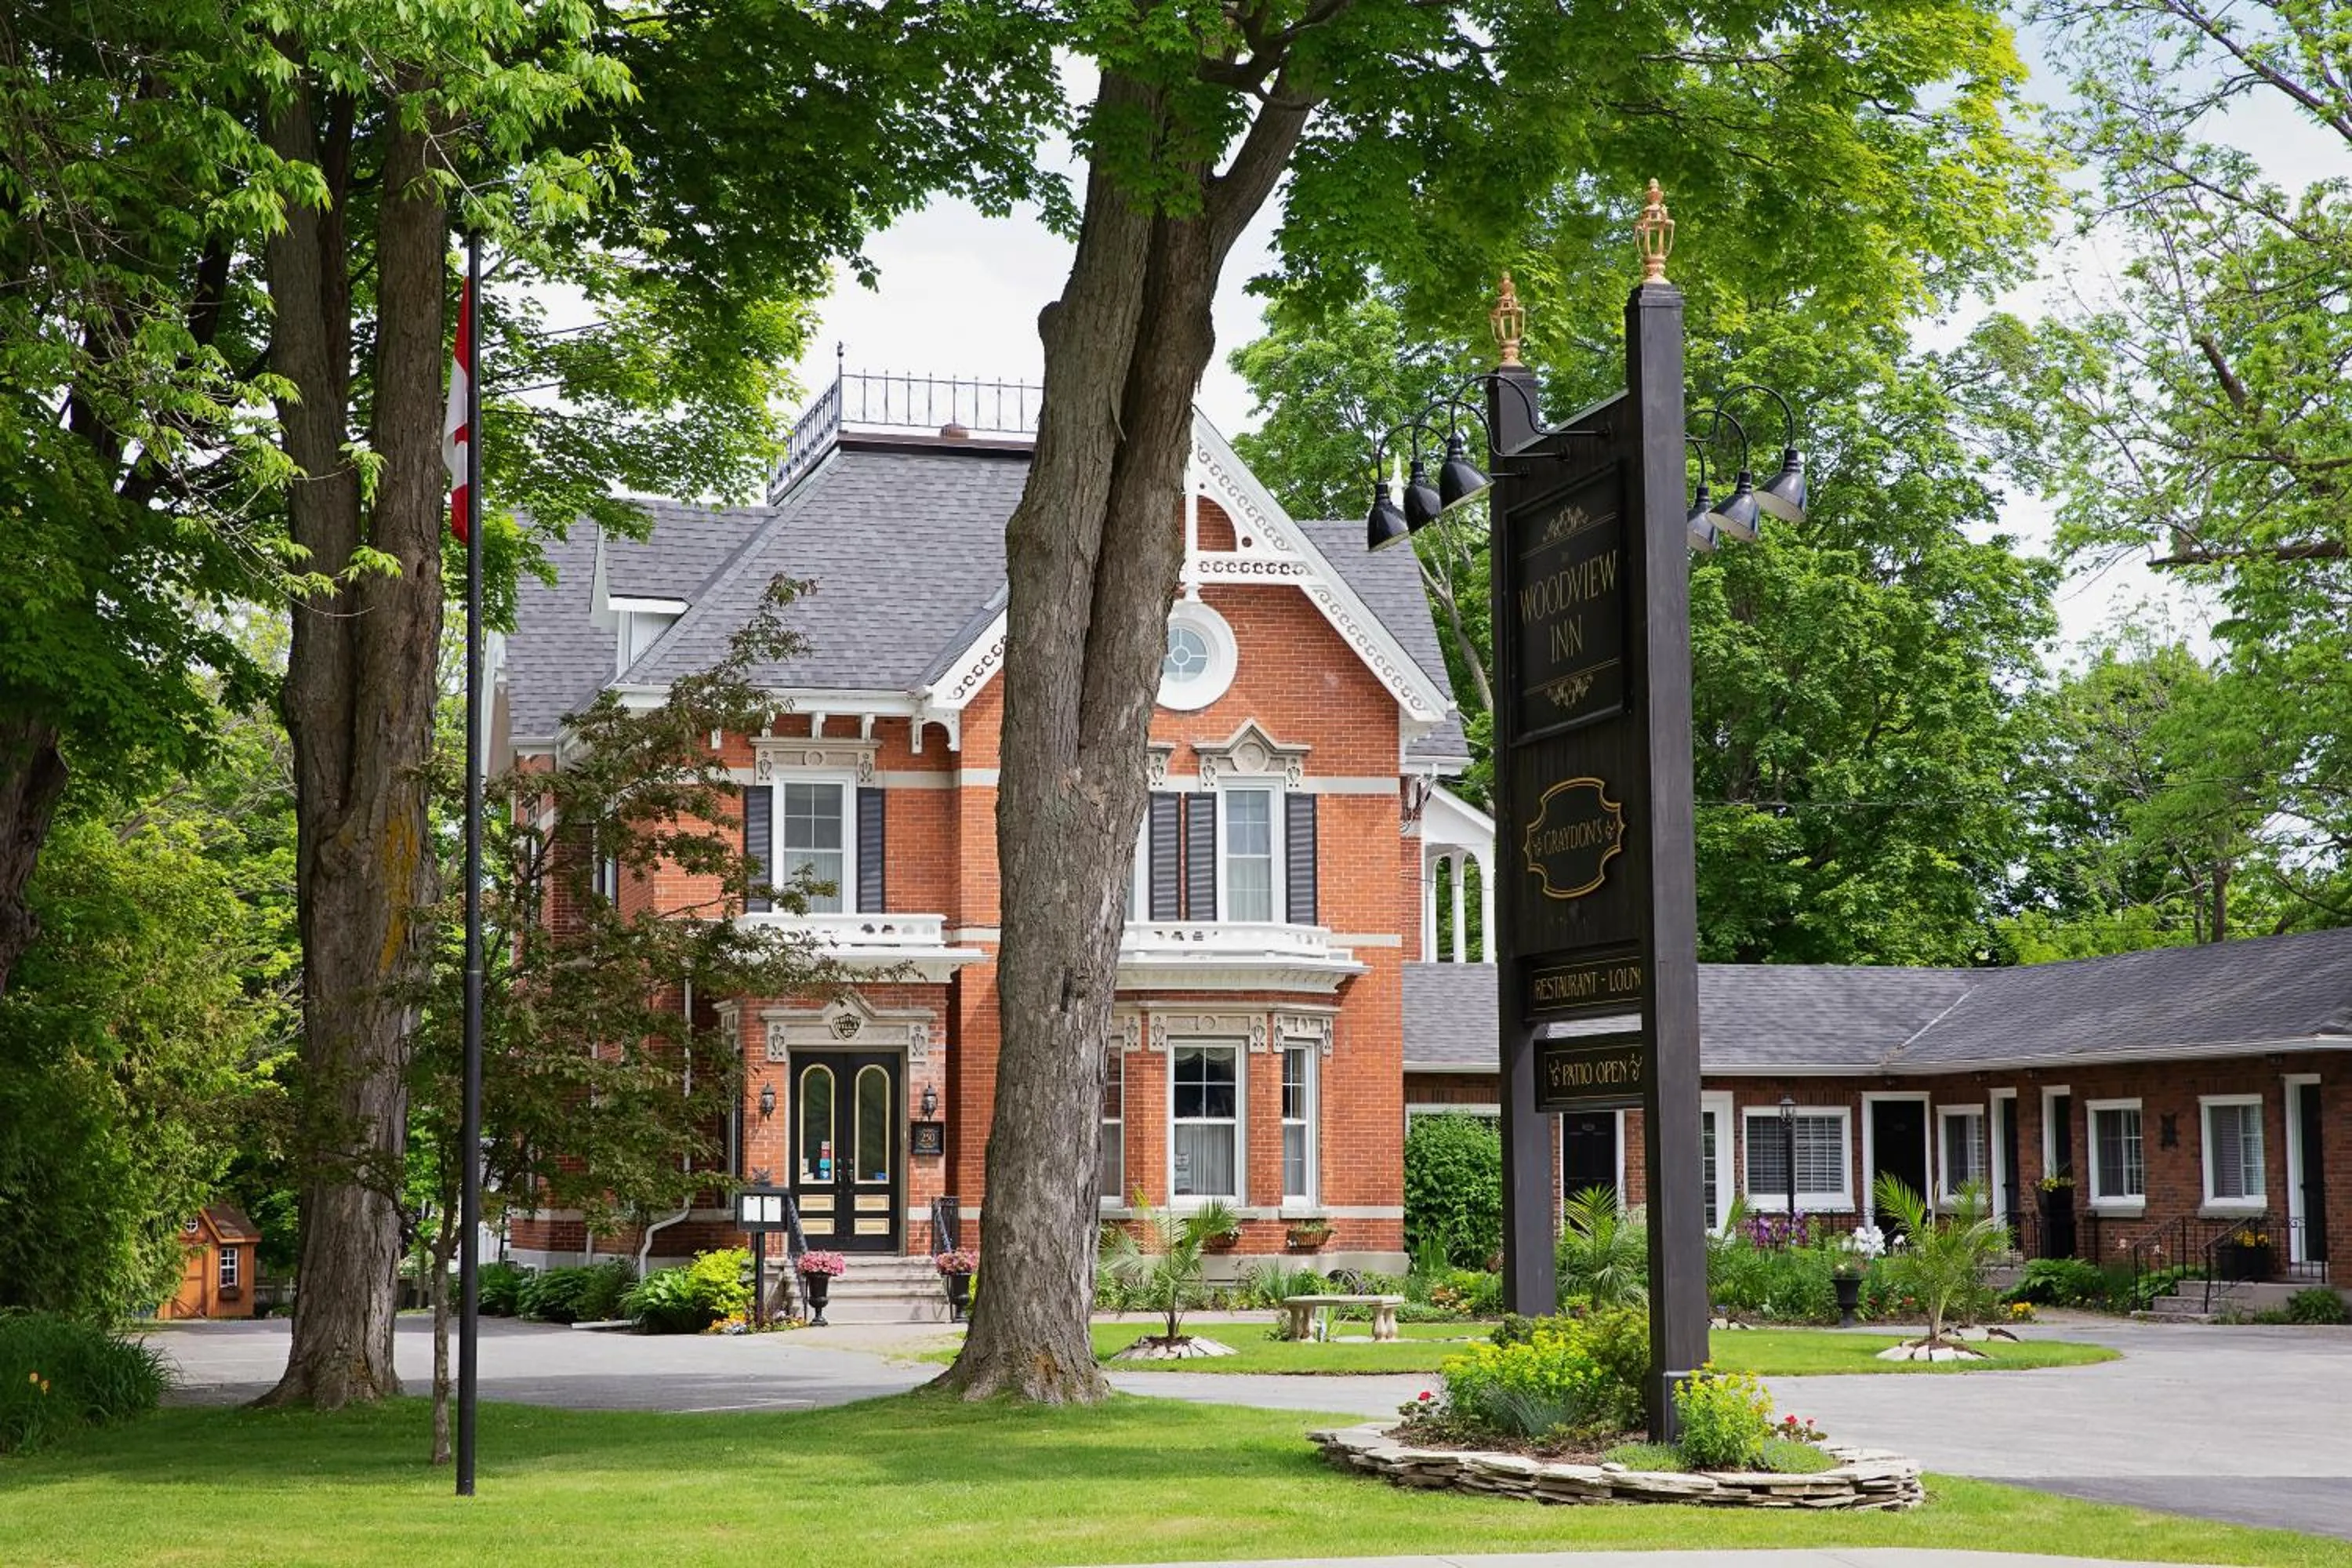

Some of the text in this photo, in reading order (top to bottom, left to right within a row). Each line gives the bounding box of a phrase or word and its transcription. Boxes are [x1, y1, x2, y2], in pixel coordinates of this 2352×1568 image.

[1519, 550, 1617, 626] WOODVIEW
[1549, 615, 1583, 664] INN
[1534, 971, 1599, 1001] RESTAURANT
[1609, 966, 1641, 993] LOUN
[1562, 1059, 1628, 1086] PATIO OPEN
